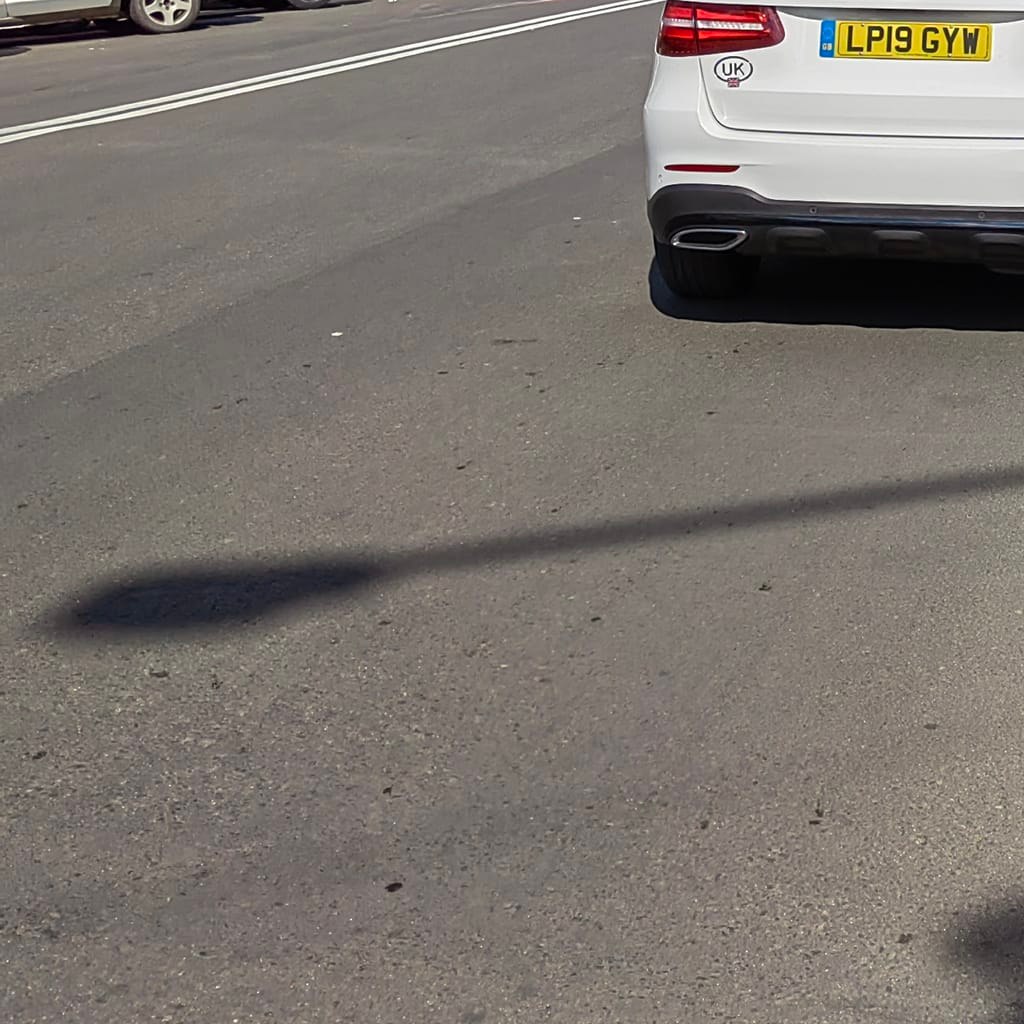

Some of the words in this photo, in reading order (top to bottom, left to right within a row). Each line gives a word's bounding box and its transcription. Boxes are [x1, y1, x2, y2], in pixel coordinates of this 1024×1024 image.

[846, 24, 913, 53] LP19
[921, 26, 980, 55] GYW
[722, 62, 745, 76] UK
